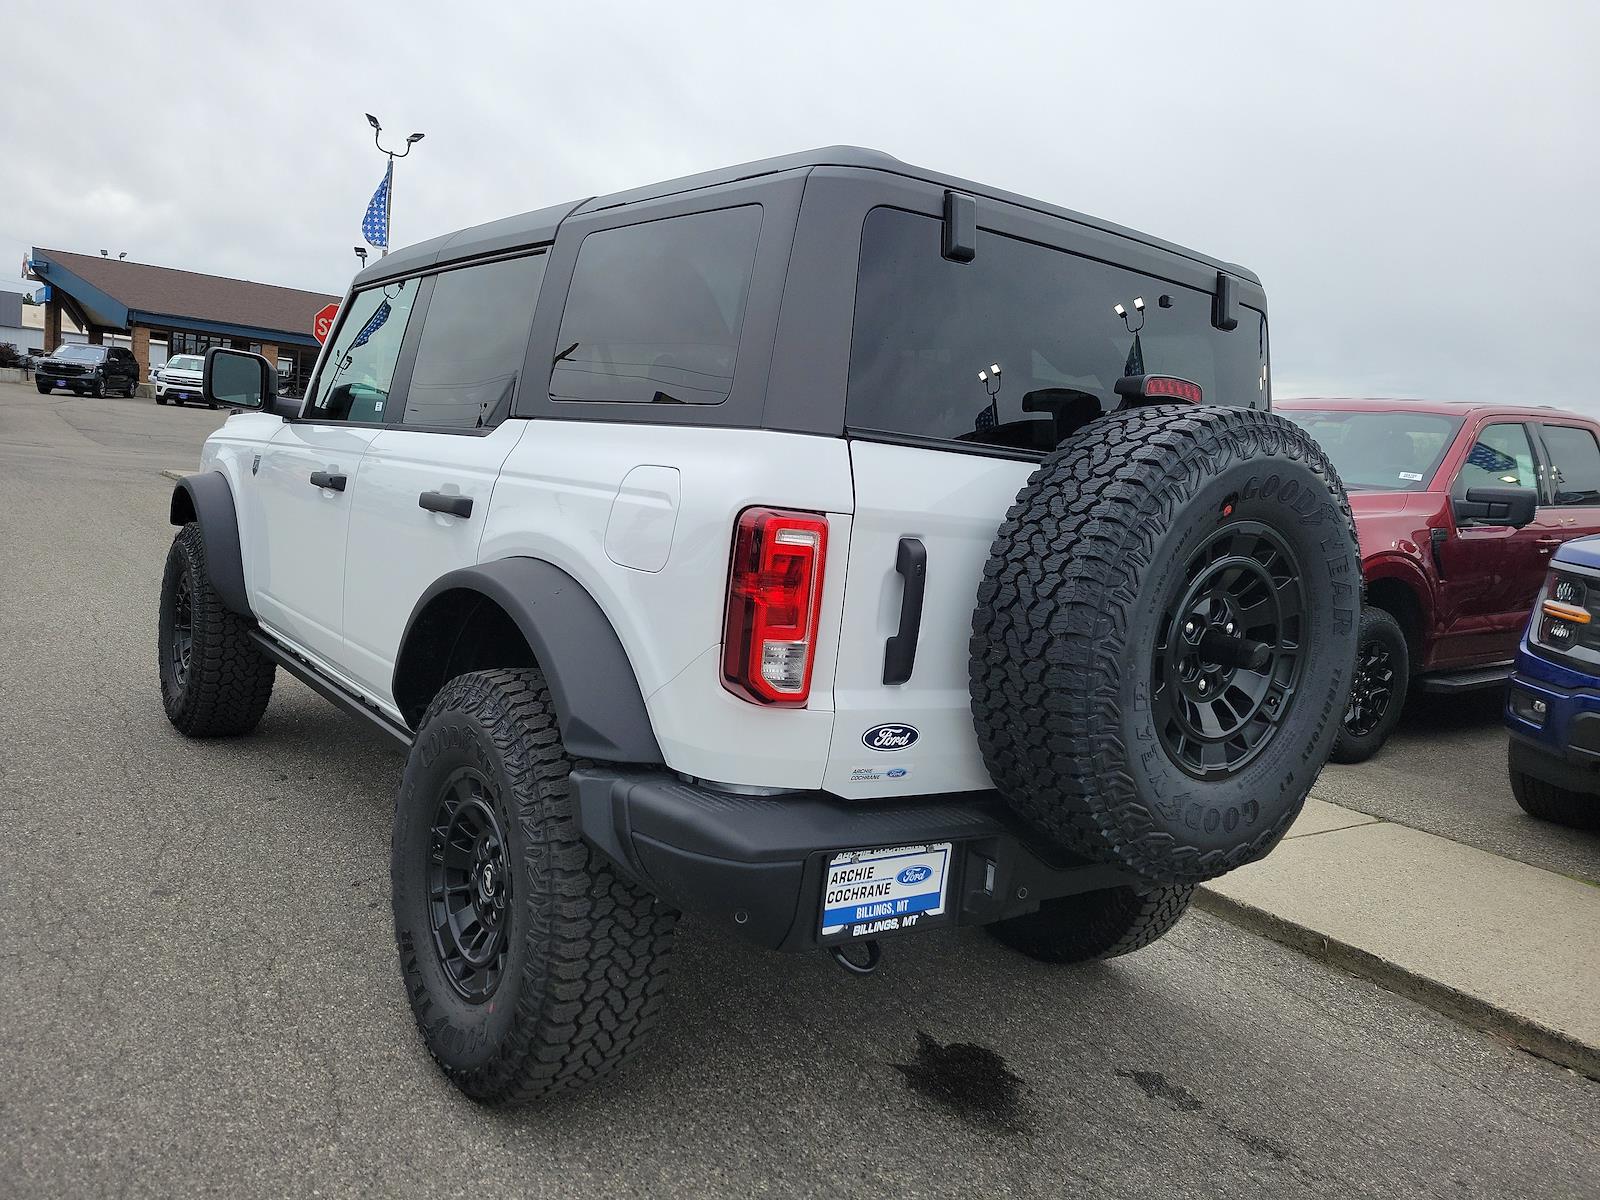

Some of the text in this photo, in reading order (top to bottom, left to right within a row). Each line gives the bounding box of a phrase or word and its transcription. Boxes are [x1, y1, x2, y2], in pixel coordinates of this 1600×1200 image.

[1241, 472, 1354, 637] GOODYEAR
[873, 727, 911, 747] Ford
[830, 866, 875, 885] ARCHIE
[827, 882, 891, 903] COCHRANE
[856, 899, 909, 919] BILLINGS, MT
[853, 914, 919, 936] BILLINGS, MT
